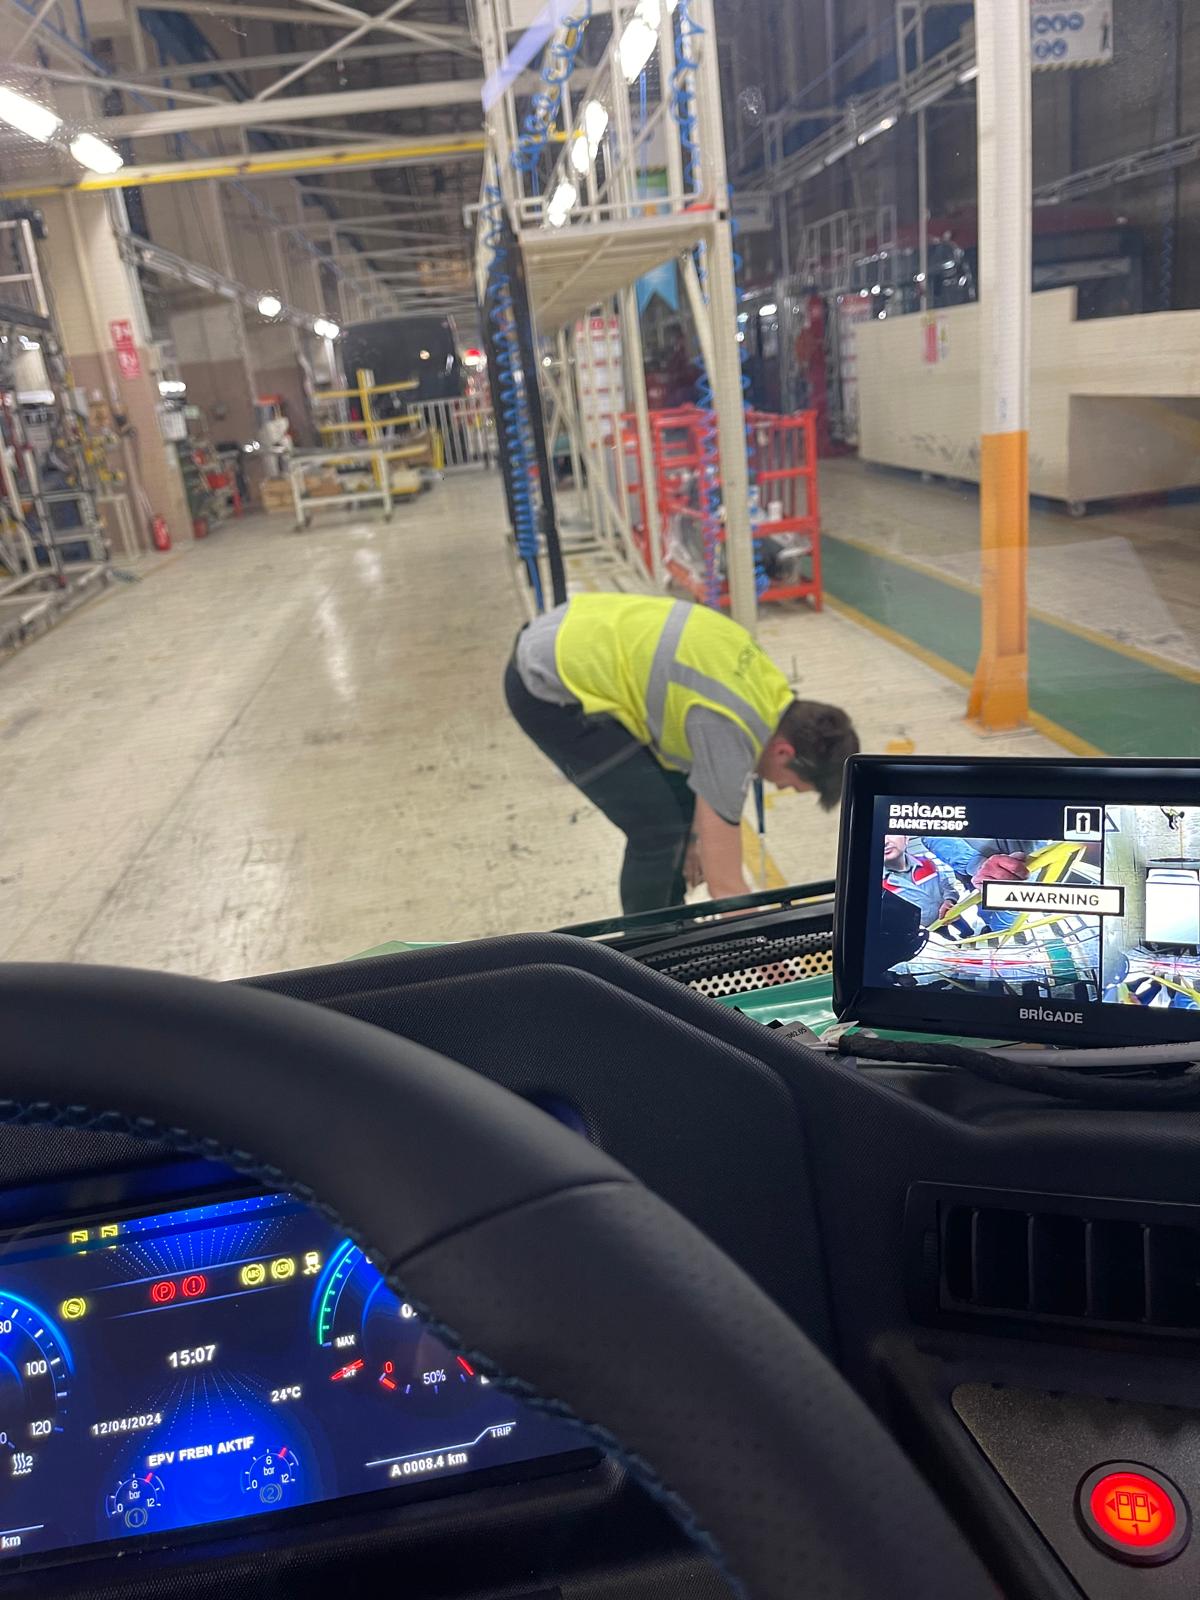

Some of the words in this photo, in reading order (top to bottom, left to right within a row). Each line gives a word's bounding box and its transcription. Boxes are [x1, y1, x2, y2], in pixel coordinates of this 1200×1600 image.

[889, 818, 969, 830] BACKEYE360°
[1020, 891, 1099, 906] WARNING
[160, 1286, 169, 1298] P
[336, 1335, 355, 1347] MAX
[169, 1344, 216, 1367] 15:07
[26, 1360, 47, 1375] 100
[385, 1361, 393, 1373] 0
[423, 1369, 446, 1384] 50%
[271, 1386, 301, 1402] 24°C
[31, 1420, 52, 1436] 120
[92, 1412, 162, 1435] 12/04/2024
[491, 1426, 512, 1438] TRIP
[148, 1451, 174, 1467] EPV
[179, 1445, 213, 1462] FREN
[217, 1436, 254, 1454] AKTIF
[266, 1455, 272, 1465] 6
[391, 1464, 401, 1477] A
[403, 1454, 444, 1474] 0008.4
[448, 1453, 468, 1466] km
[263, 1466, 275, 1476] bar
[132, 1480, 138, 1489] 6
[252, 1479, 258, 1489] 0
[281, 1473, 289, 1483] 12
[129, 1490, 141, 1500] bar
[117, 1503, 123, 1513] 0
[147, 1498, 155, 1507] 12
[1132, 1523, 1140, 1536] 1
[2, 1535, 21, 1549] km
